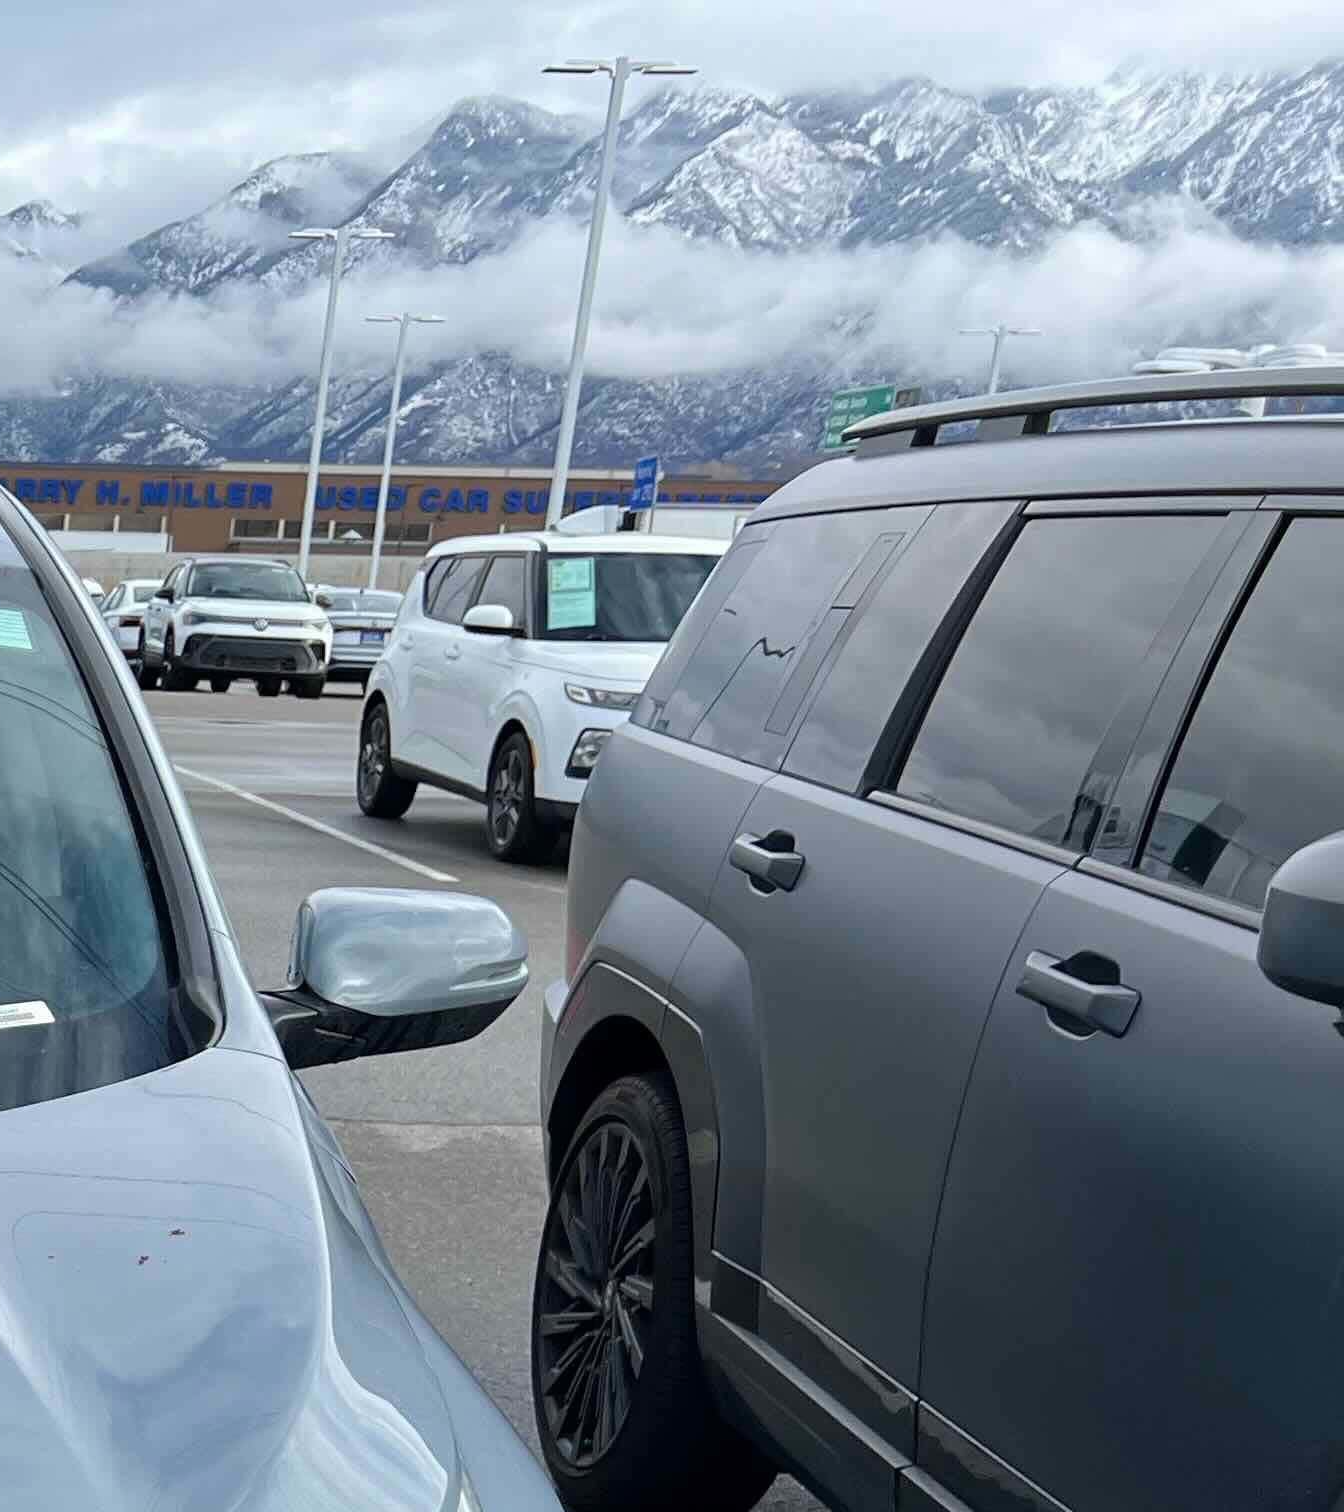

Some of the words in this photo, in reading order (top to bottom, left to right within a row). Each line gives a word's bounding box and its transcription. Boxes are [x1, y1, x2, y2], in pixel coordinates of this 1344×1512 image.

[140, 480, 273, 510] MILLER
[314, 486, 408, 513] USED
[419, 487, 489, 514] CAR
